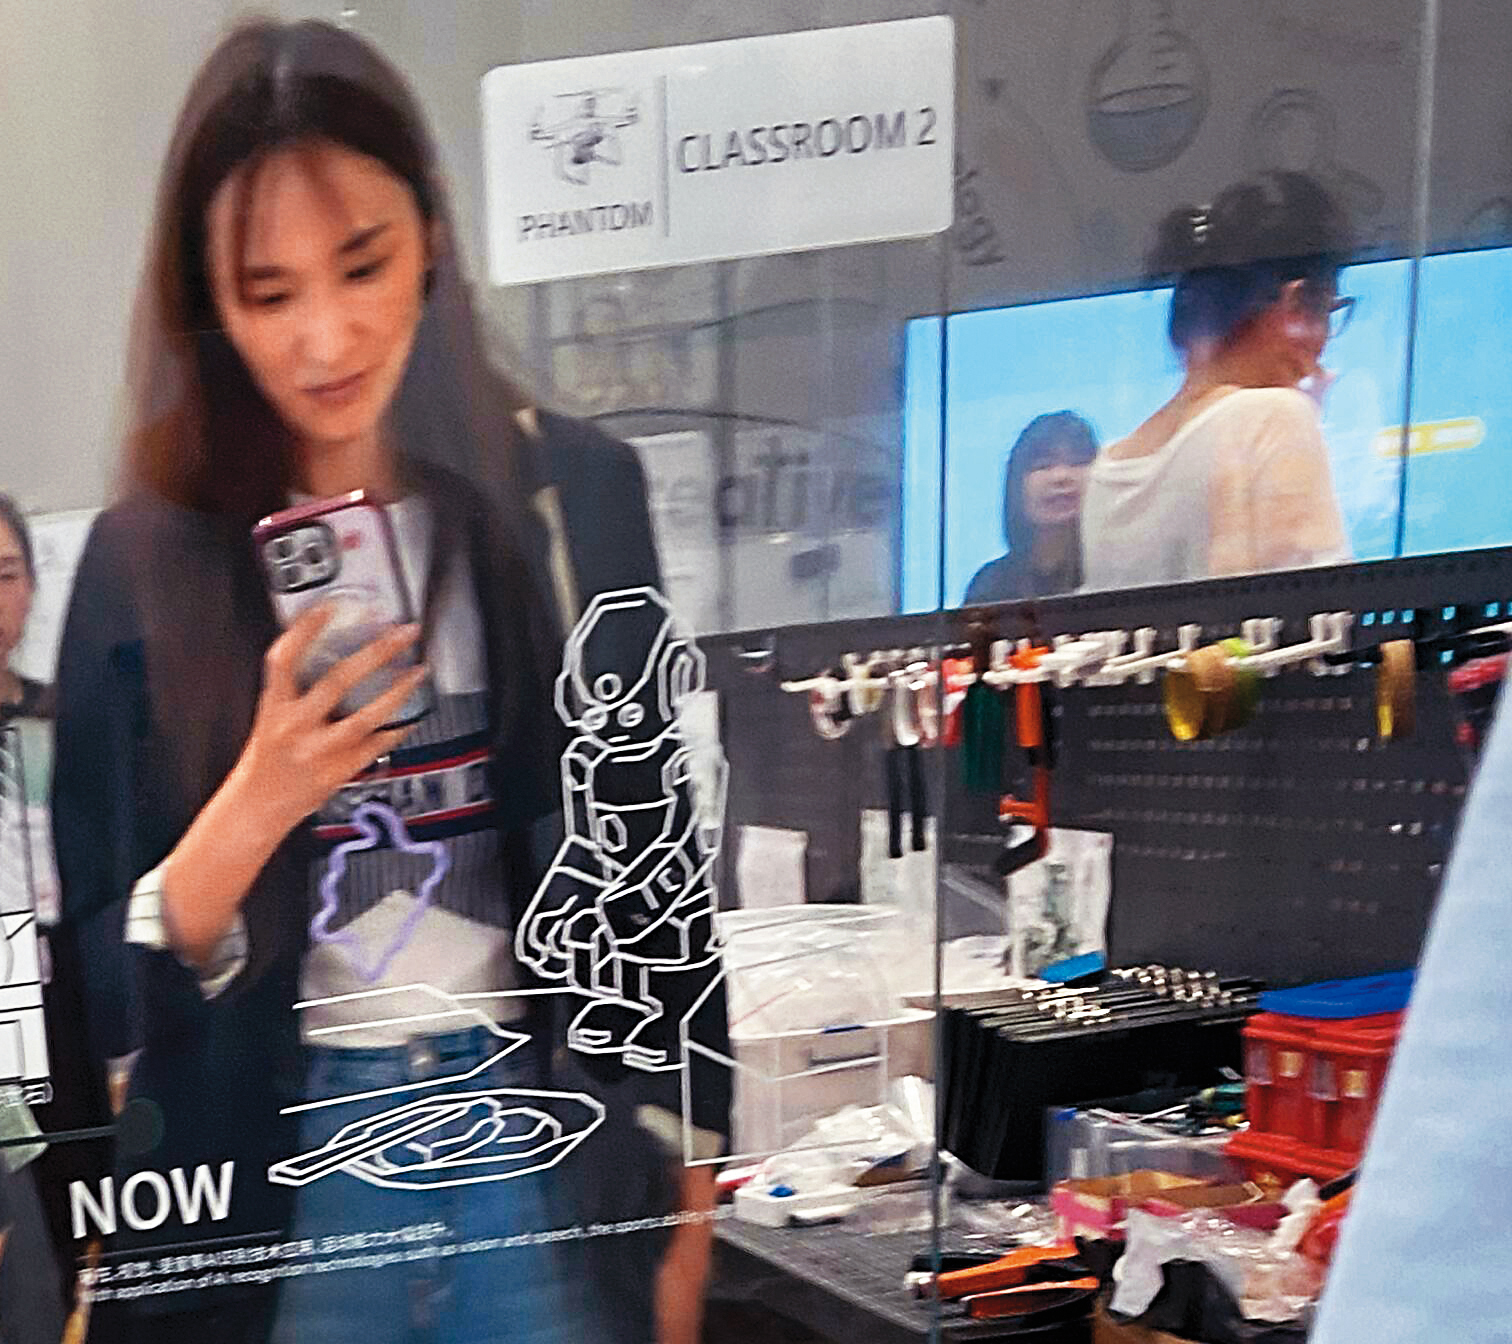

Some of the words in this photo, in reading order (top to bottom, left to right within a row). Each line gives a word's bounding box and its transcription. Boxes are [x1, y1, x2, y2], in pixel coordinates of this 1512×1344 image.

[676, 110, 907, 174] CLASSROOM
[915, 105, 938, 147] 2
[517, 200, 654, 243] PHANTOM
[67, 1160, 235, 1239] NOW
